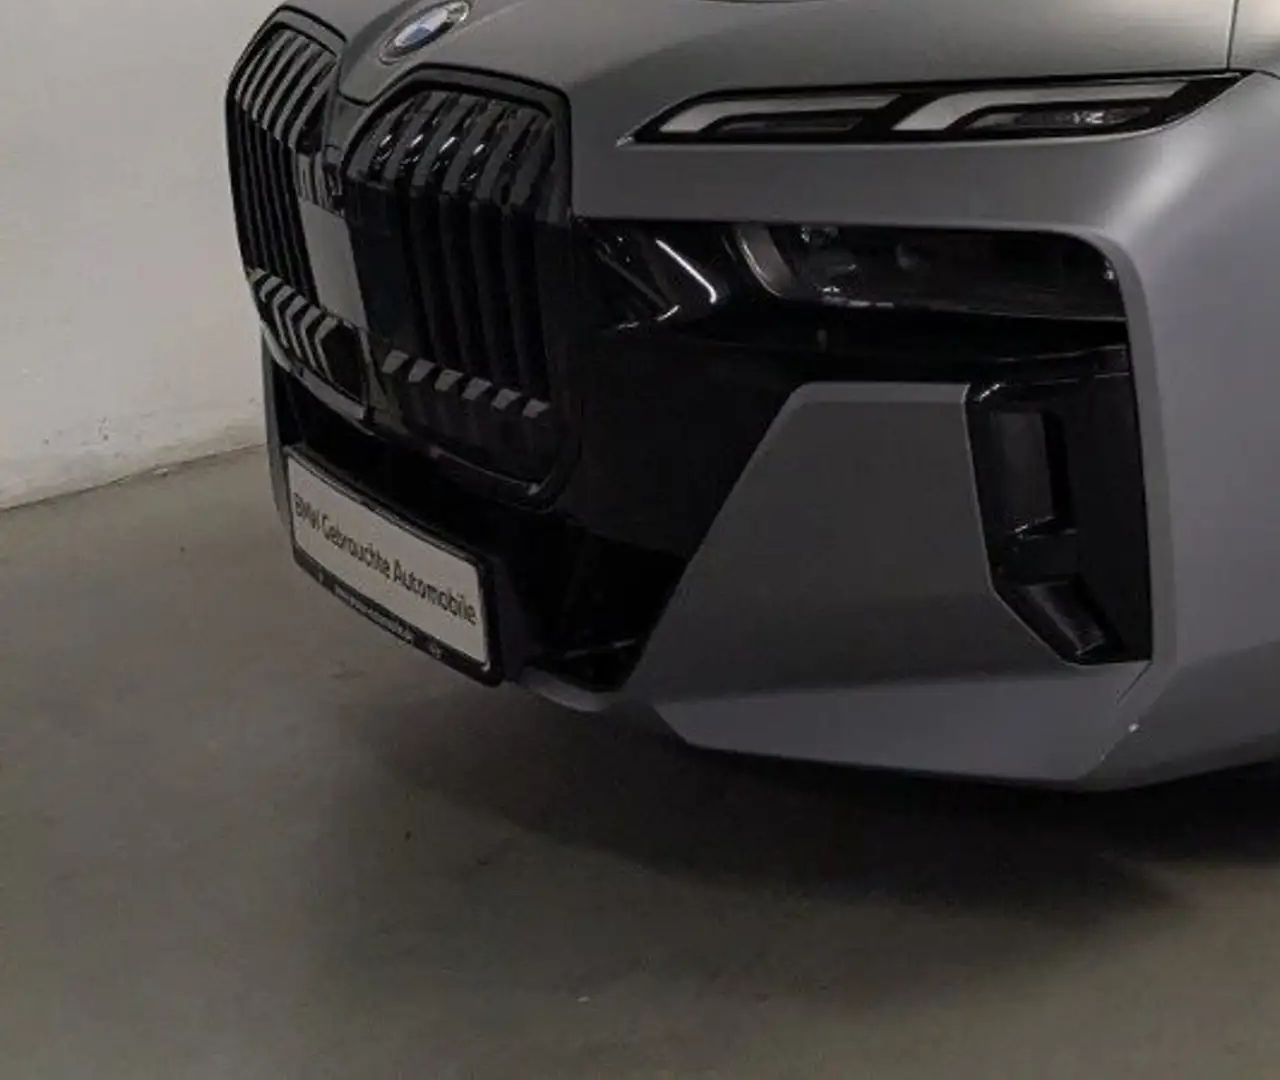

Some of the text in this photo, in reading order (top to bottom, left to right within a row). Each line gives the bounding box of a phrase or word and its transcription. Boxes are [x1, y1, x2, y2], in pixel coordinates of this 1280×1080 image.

[294, 491, 321, 533] BMW
[321, 513, 391, 580] Gebrauchte
[392, 558, 479, 627] Automobile
